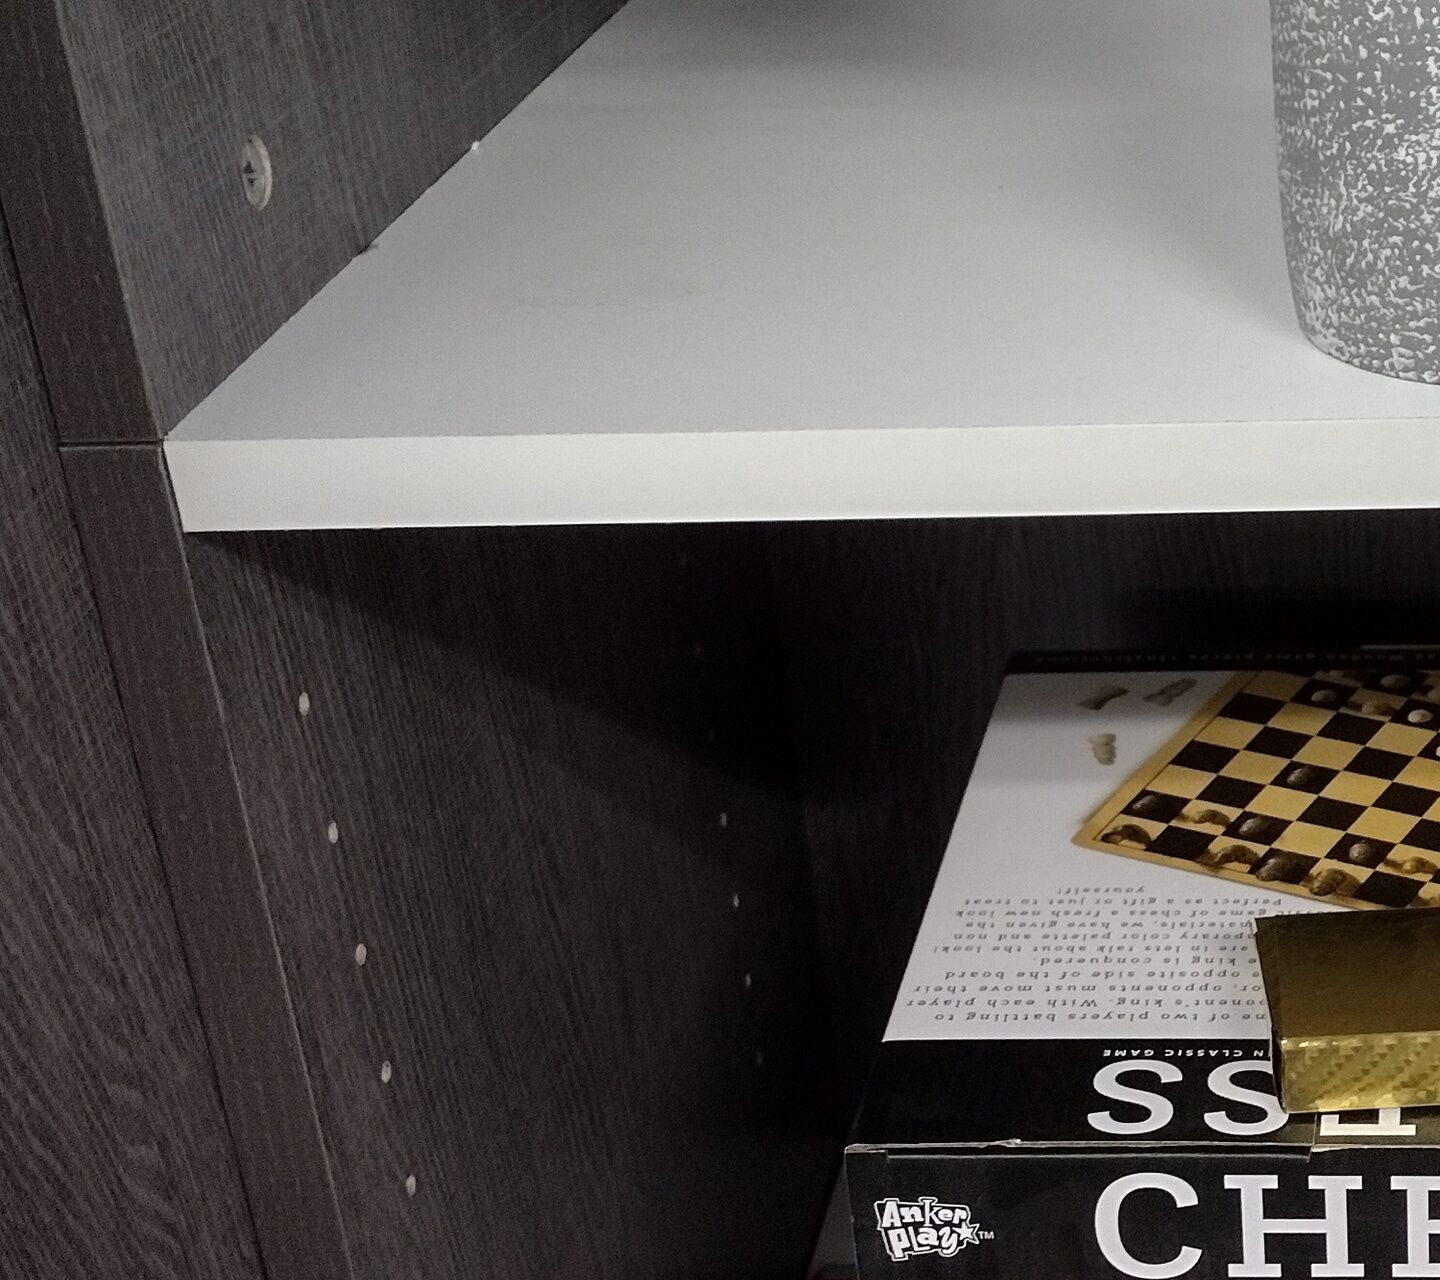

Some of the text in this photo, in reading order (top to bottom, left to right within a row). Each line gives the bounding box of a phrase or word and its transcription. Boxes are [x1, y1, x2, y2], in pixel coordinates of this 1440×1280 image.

[1123, 897, 1156, 906] gift
[1051, 910, 1100, 918] fresh
[1129, 910, 1180, 918] chess
[1190, 910, 1208, 918] of
[1006, 921, 1057, 929] given
[1041, 932, 1111, 941] palette
[992, 945, 1022, 953] the
[1032, 945, 1086, 953] about
[1096, 945, 1134, 953] talk
[1144, 945, 1180, 953] lets
[1191, 956, 1236, 966] king
[944, 970, 1240, 980] opposite side of the board
[913, 985, 967, 994] their
[1108, 983, 1222, 992] opponents
[906, 997, 976, 1008] player
[987, 999, 1035, 1008] each
[1047, 999, 1097, 1008] With
[934, 1013, 954, 1021] to
[965, 1012, 1056, 1022] battling
[1068, 1011, 1149, 1022] players
[1208, 1013, 1230, 1022] of
[1102, 1049, 1243, 1057] CLASSIC GAME
[881, 1198, 968, 1228] Anker
